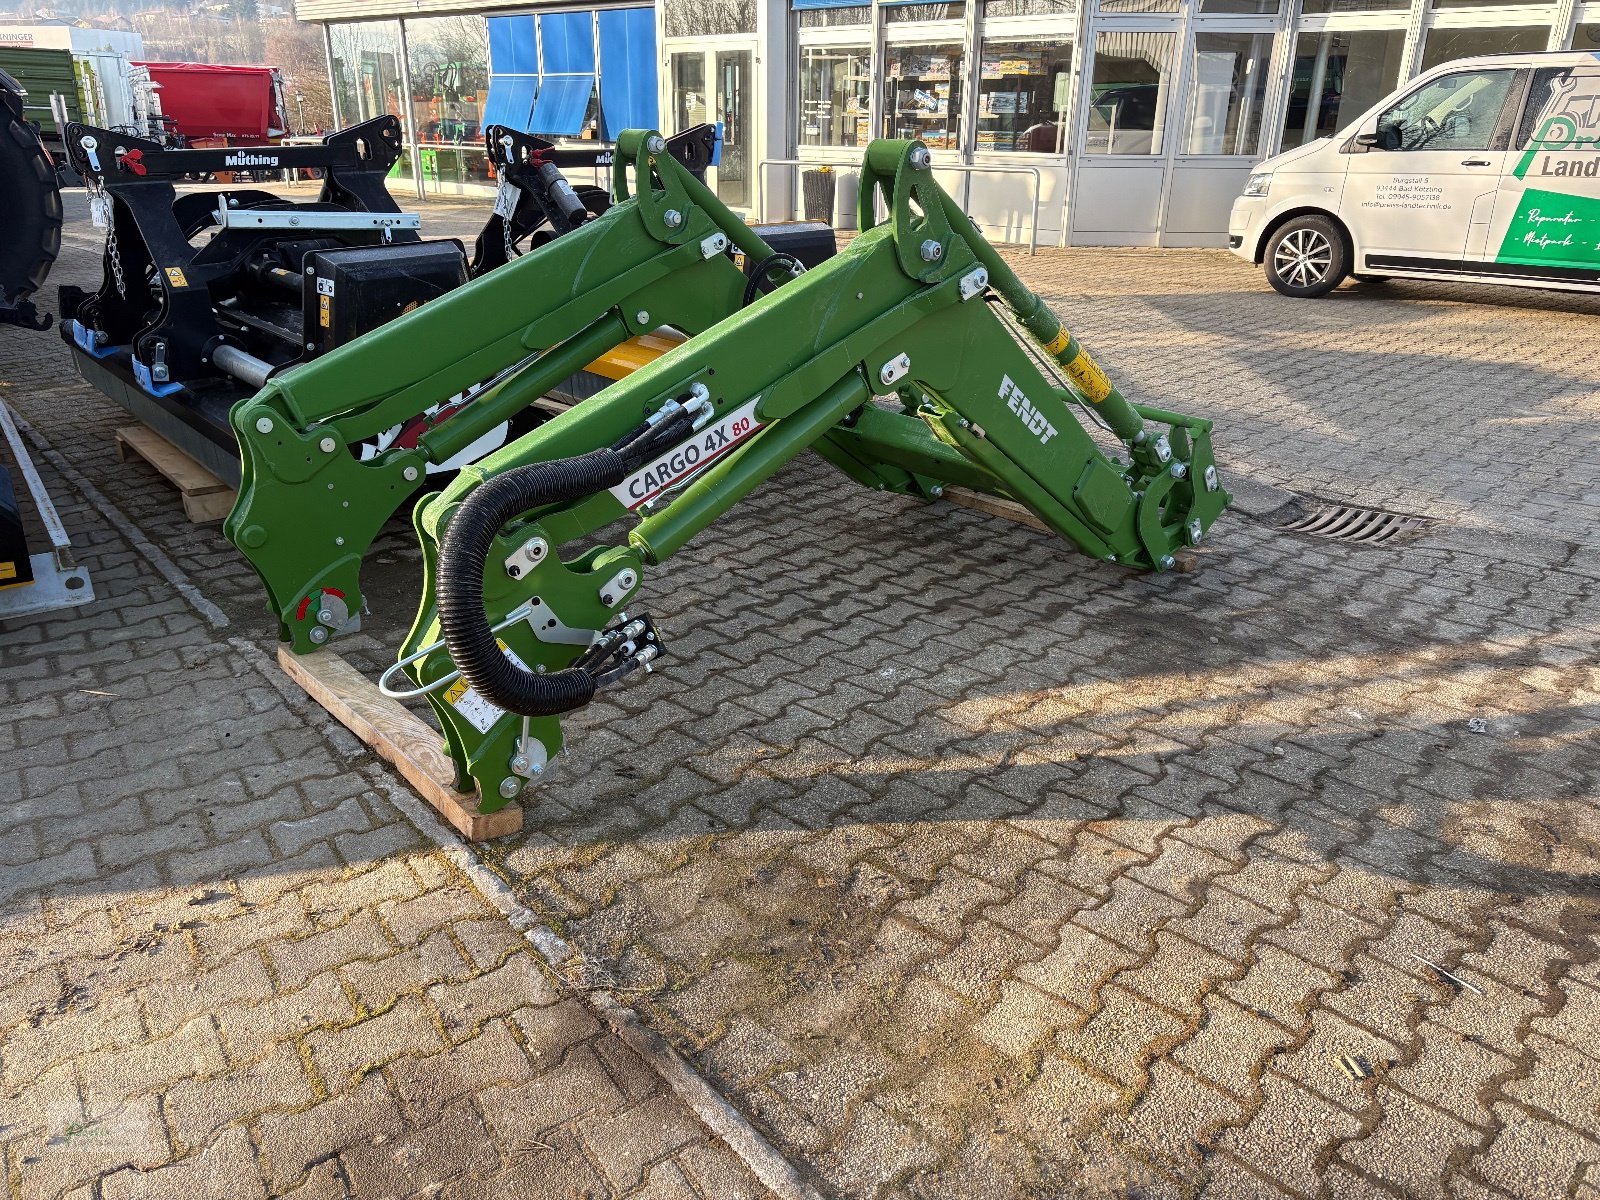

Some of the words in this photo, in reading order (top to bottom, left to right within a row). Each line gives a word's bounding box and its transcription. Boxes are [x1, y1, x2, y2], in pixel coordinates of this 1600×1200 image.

[225, 150, 279, 167] Müthing
[997, 373, 1059, 445] FENDT
[628, 444, 700, 499] CARGO
[704, 424, 730, 453] 4X
[732, 416, 750, 437] 80
